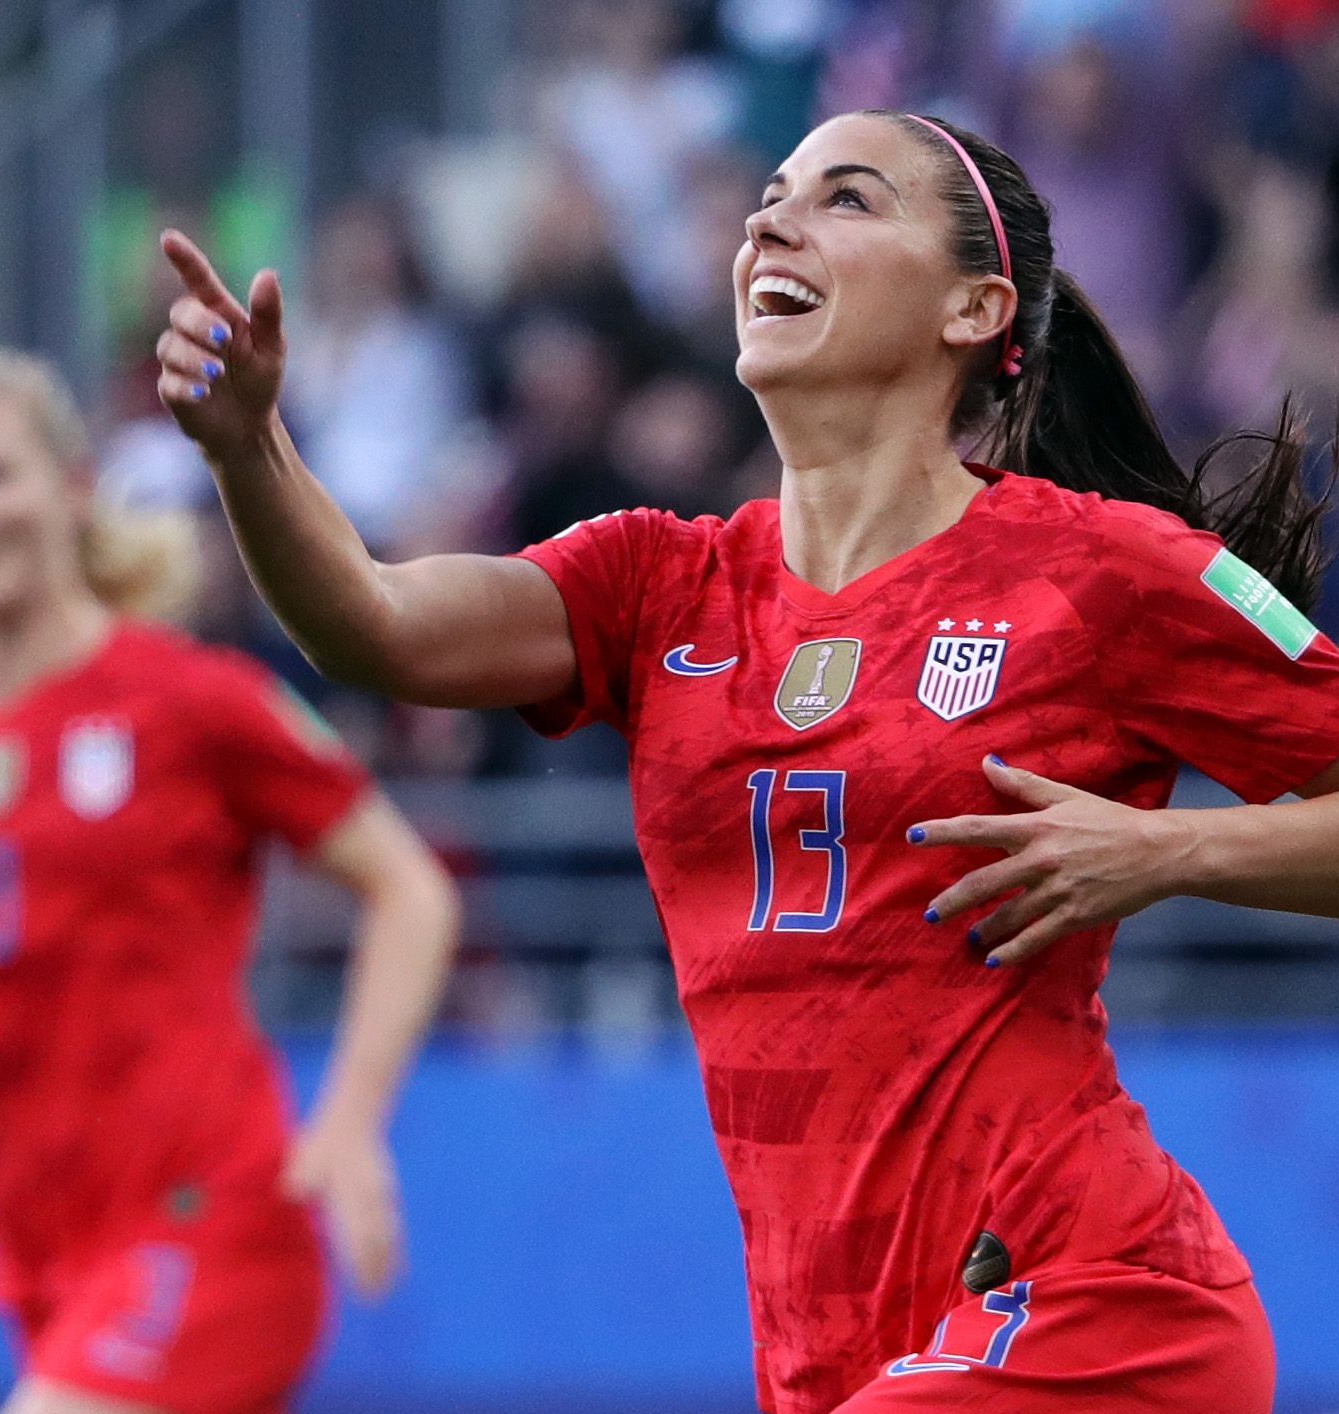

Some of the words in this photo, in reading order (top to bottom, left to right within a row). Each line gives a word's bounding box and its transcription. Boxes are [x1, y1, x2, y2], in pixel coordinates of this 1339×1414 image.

[933, 641, 999, 673] USA
[793, 695, 827, 706] FIFA
[746, 768, 848, 933] 13
